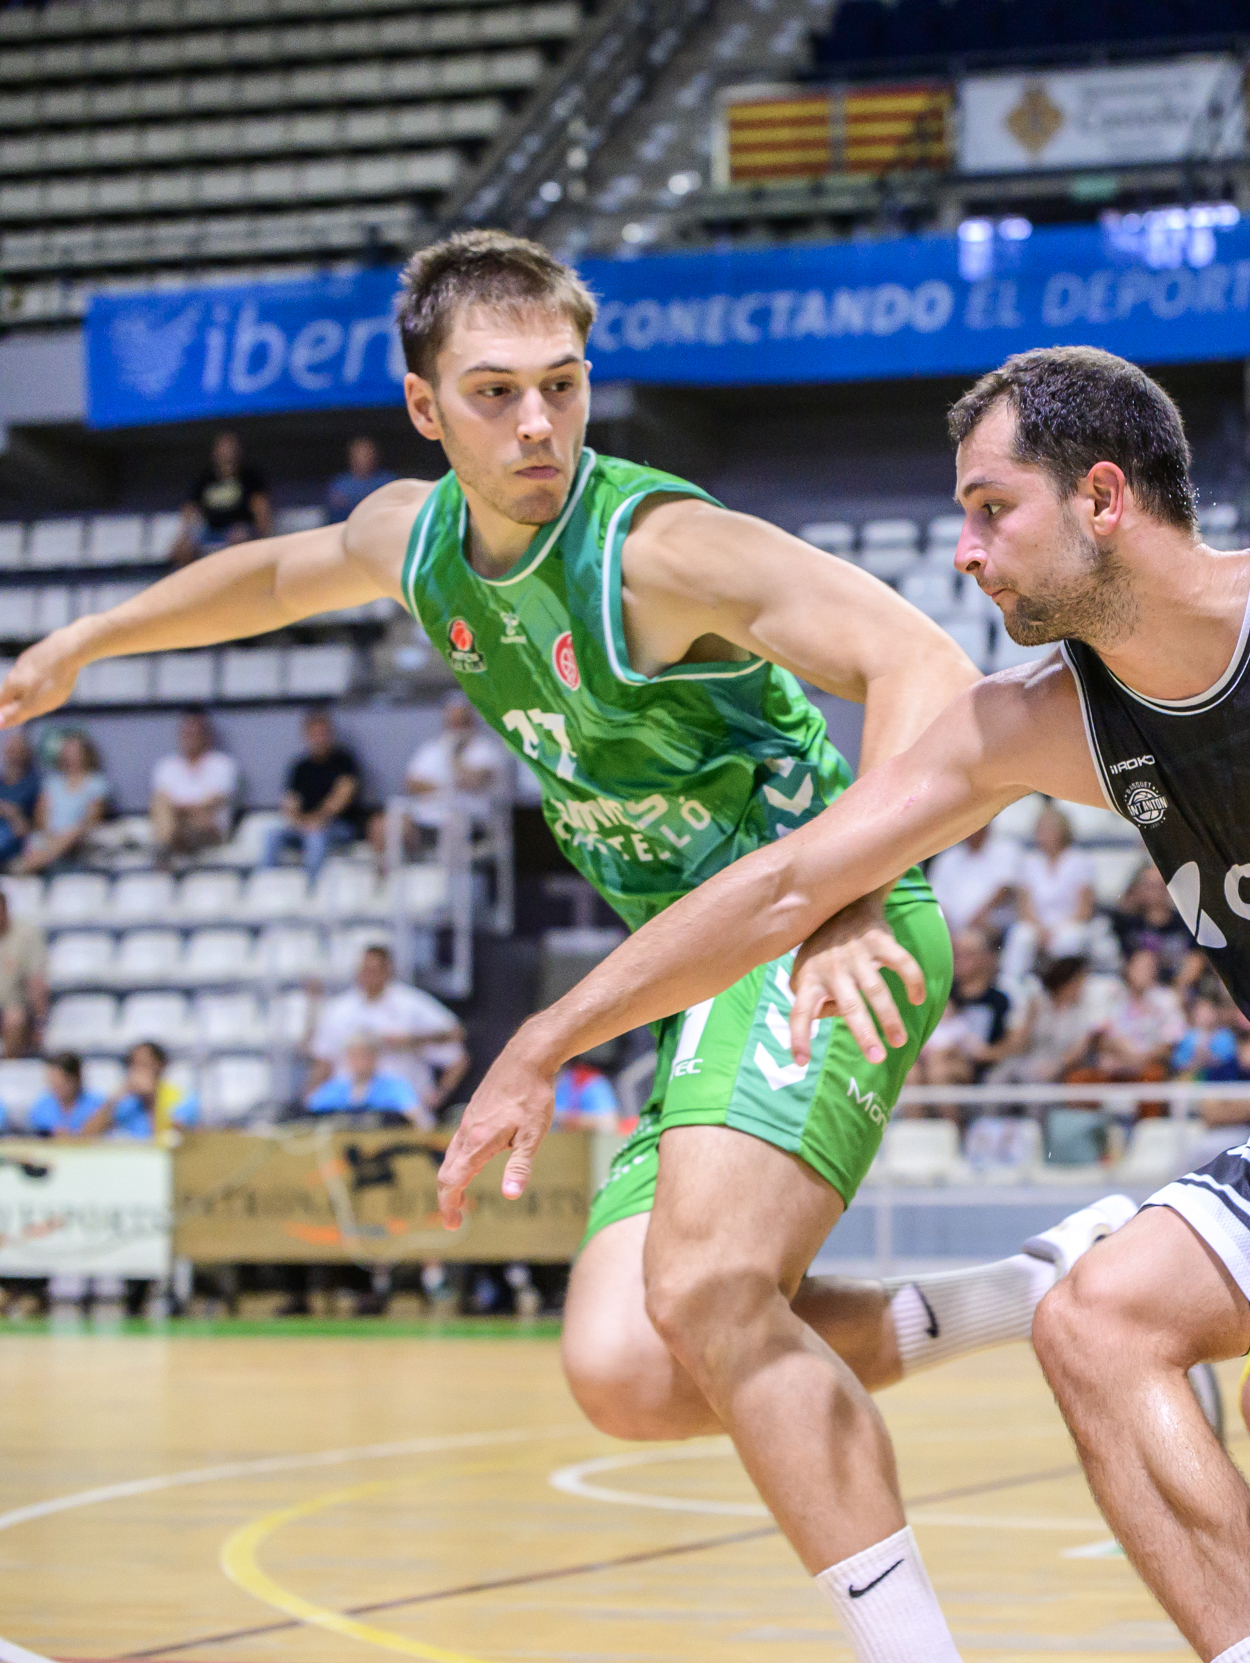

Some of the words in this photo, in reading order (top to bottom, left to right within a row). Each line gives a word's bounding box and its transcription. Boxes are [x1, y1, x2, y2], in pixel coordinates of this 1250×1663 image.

[593, 279, 953, 350] CONECTANDO
[965, 279, 1024, 330] EL
[501, 708, 577, 782] 17
[1126, 781, 1152, 795] BASQUET
